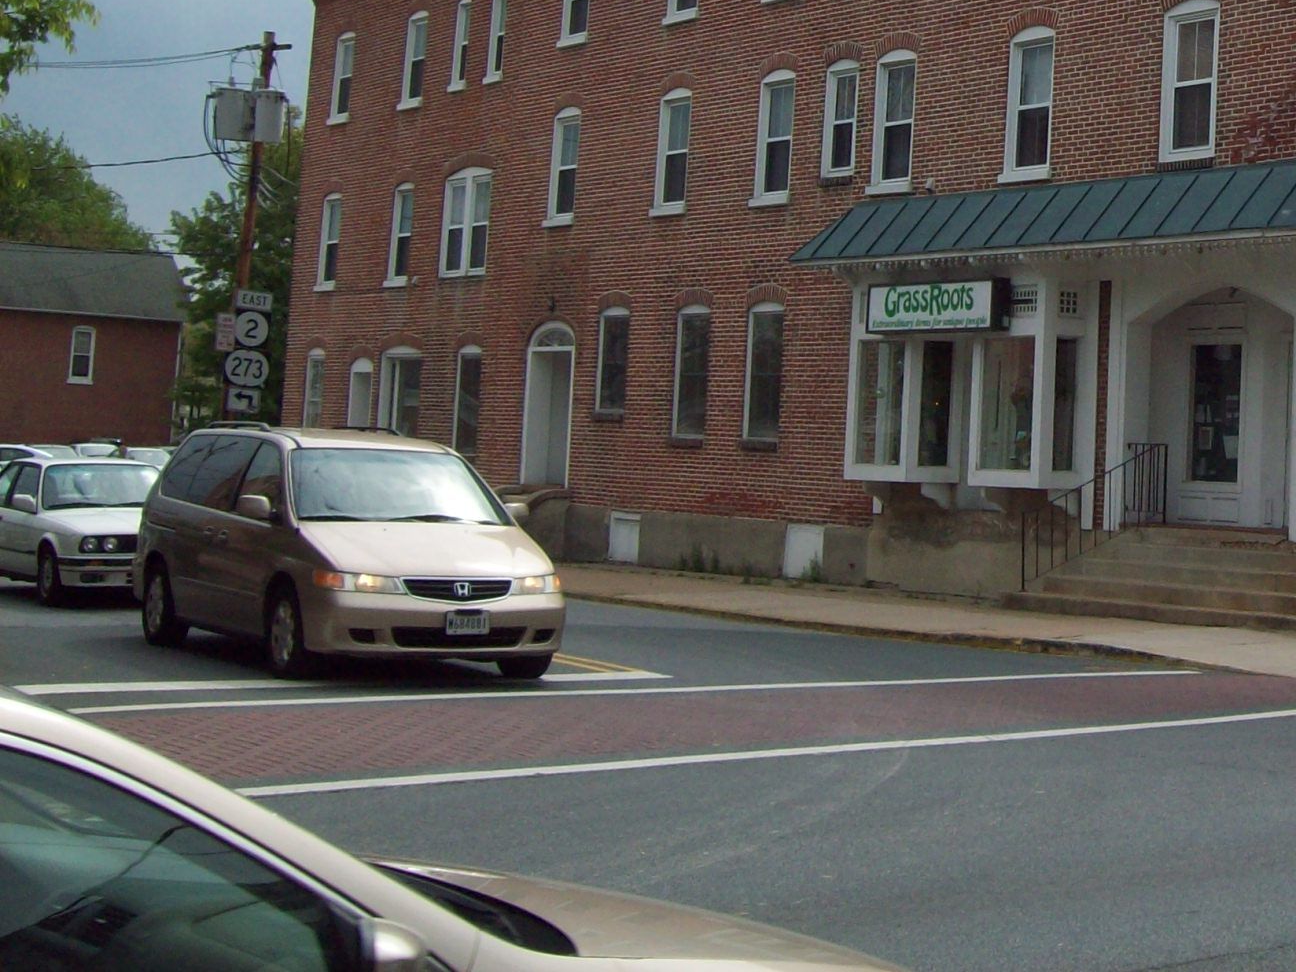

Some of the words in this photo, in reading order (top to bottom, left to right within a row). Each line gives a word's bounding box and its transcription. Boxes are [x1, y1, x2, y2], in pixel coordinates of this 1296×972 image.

[242, 293, 267, 306] EAST
[884, 284, 974, 318] GrassRoots
[244, 318, 259, 339] 2
[231, 356, 263, 379] 273
